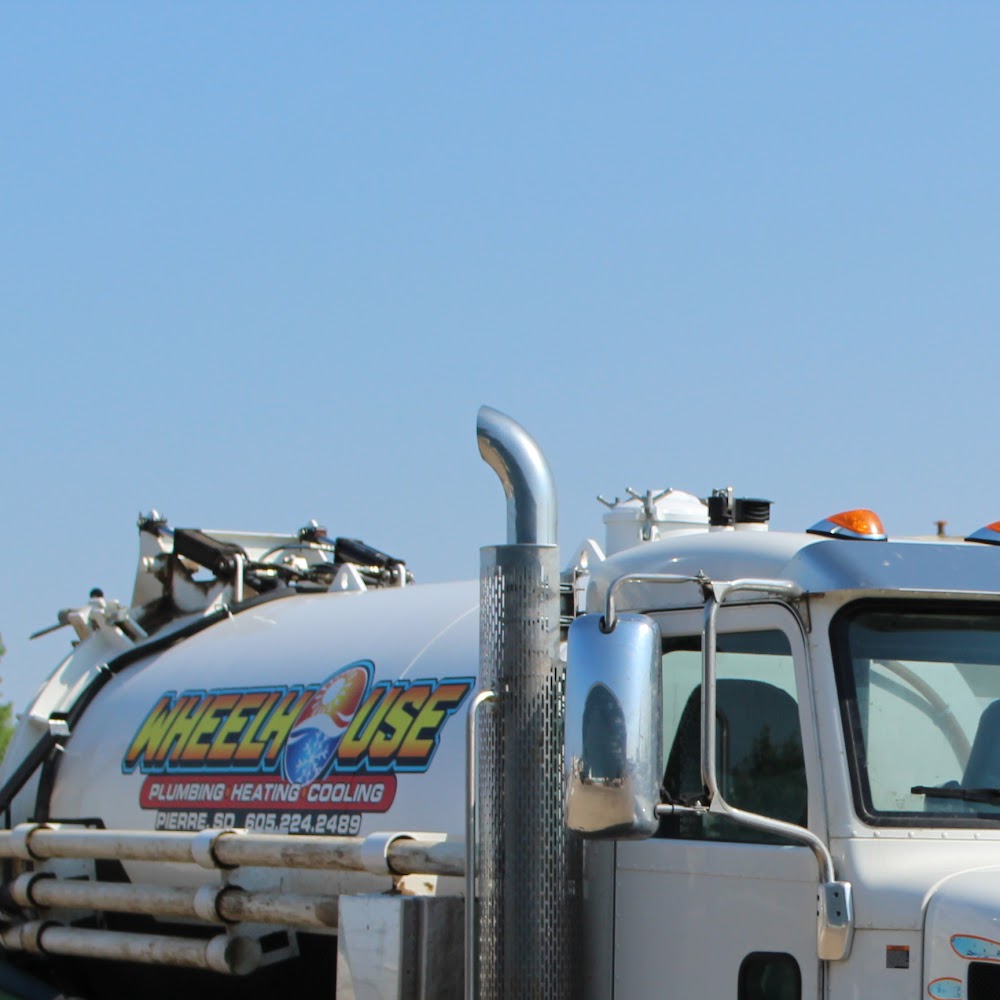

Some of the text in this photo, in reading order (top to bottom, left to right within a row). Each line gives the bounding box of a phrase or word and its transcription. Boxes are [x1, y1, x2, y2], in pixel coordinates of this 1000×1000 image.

[148, 783, 385, 803] PLUMBING HEATING COOLING
[213, 813, 236, 830] SD
[244, 812, 361, 834] 605.224.2489
